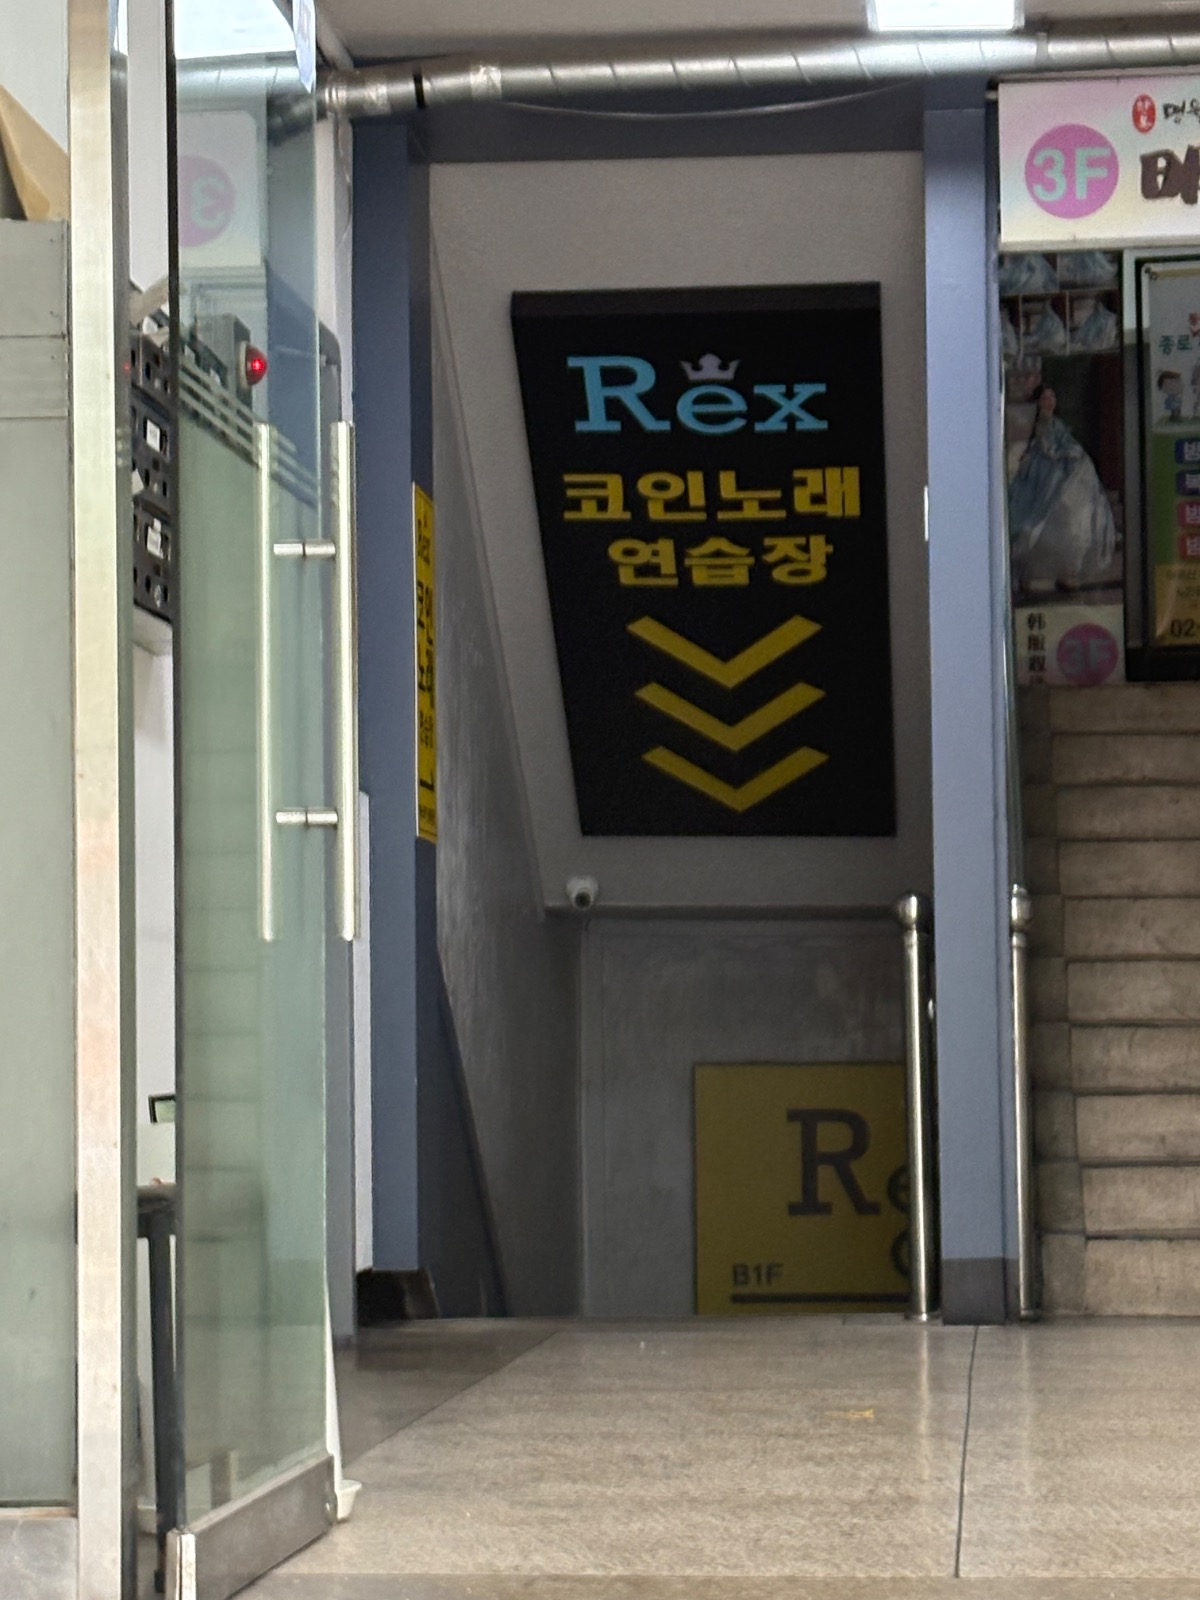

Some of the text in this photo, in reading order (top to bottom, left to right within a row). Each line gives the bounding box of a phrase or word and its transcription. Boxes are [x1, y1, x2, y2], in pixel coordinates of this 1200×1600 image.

[1032, 145, 1112, 203] 3F
[566, 355, 829, 434] Rex
[562, 466, 861, 521] 코인노래
[607, 534, 834, 587] 연습장
[731, 1262, 784, 1287] B1F
